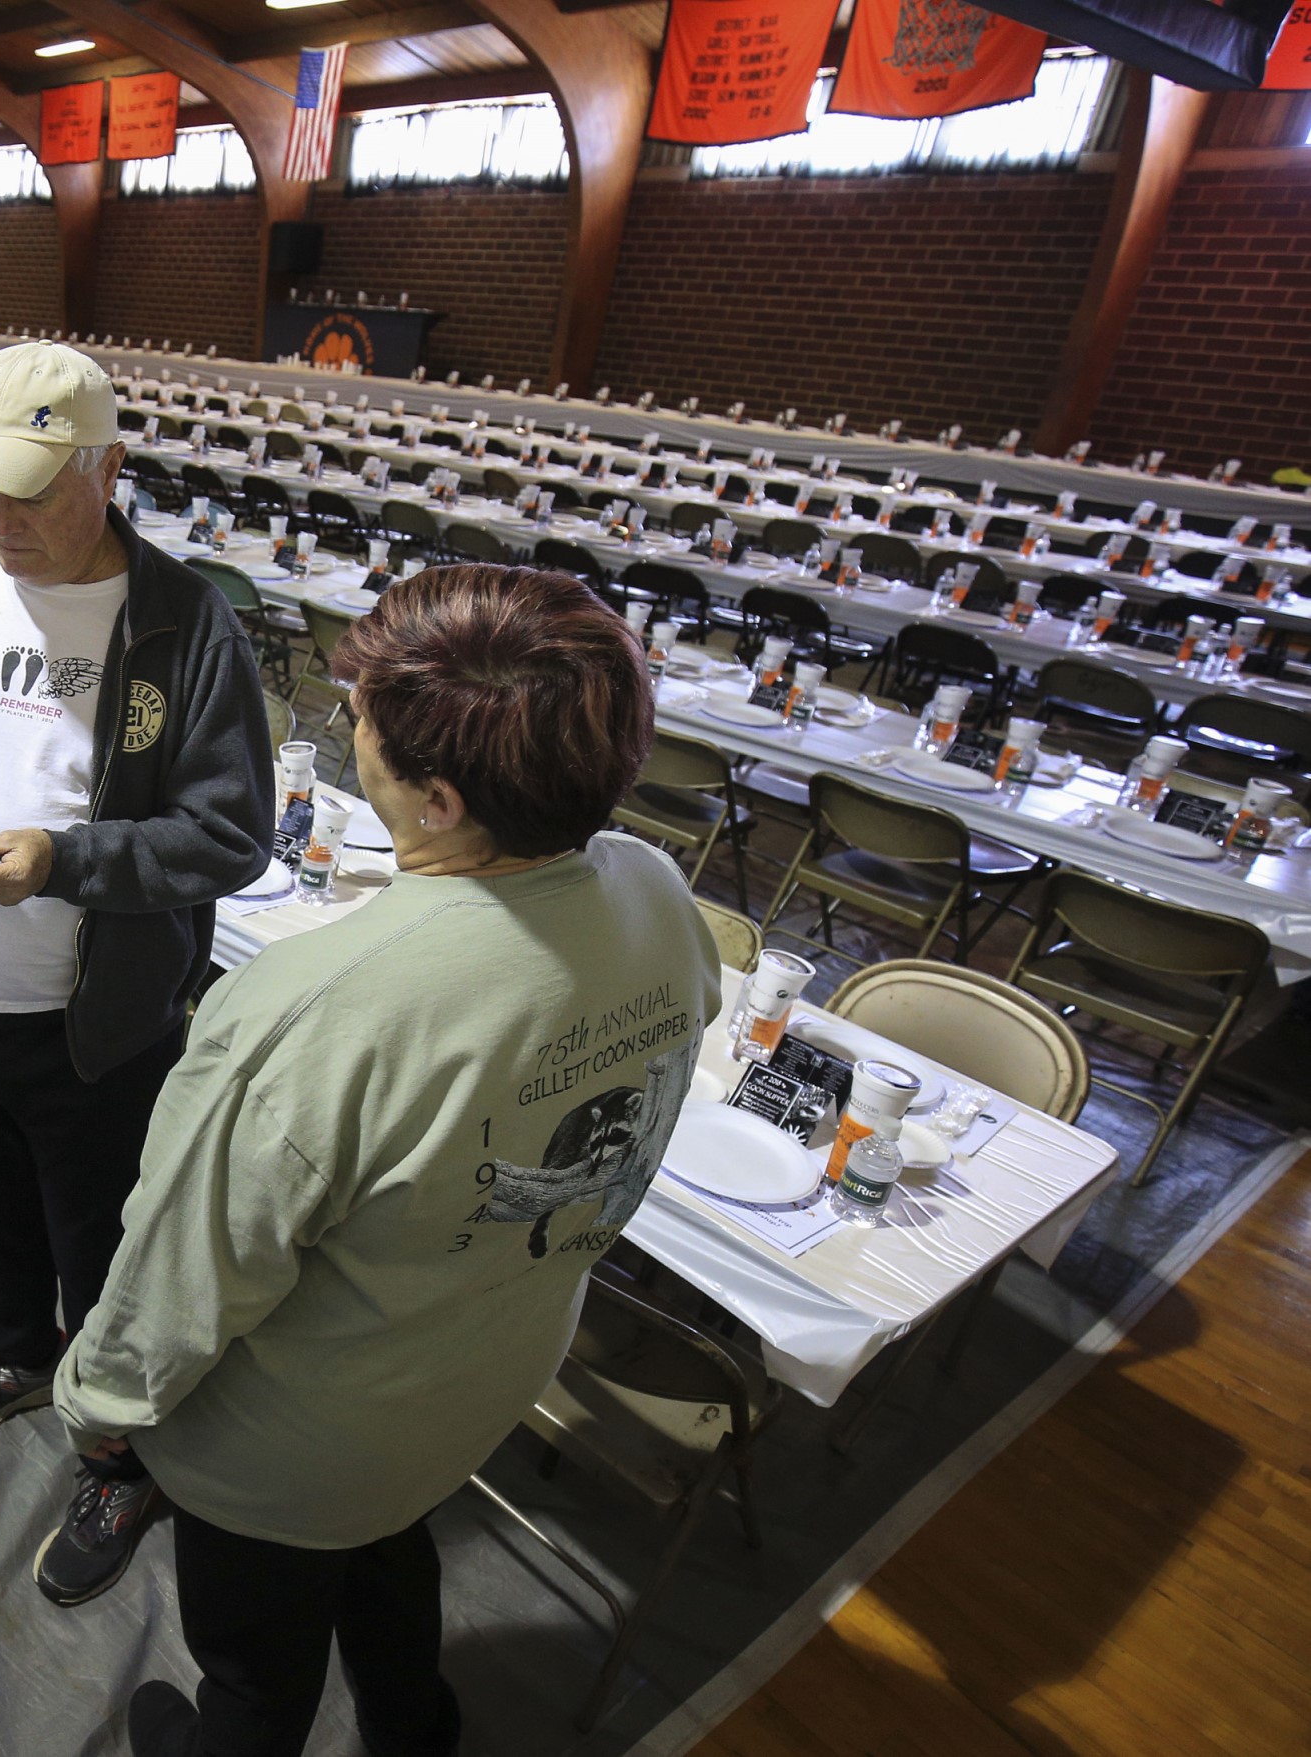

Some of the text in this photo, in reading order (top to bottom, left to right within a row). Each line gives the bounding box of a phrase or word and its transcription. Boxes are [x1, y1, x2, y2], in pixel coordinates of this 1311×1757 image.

[0, 697, 63, 719] REMEMBER
[130, 685, 162, 715] CEDAR
[127, 729, 153, 747] DGE
[537, 982, 679, 1073] 75th ANNUAL
[518, 1012, 689, 1106] GILLETT COON SUPPER
[746, 1082, 766, 1095] COON
[764, 1091, 791, 1107] SUPPER
